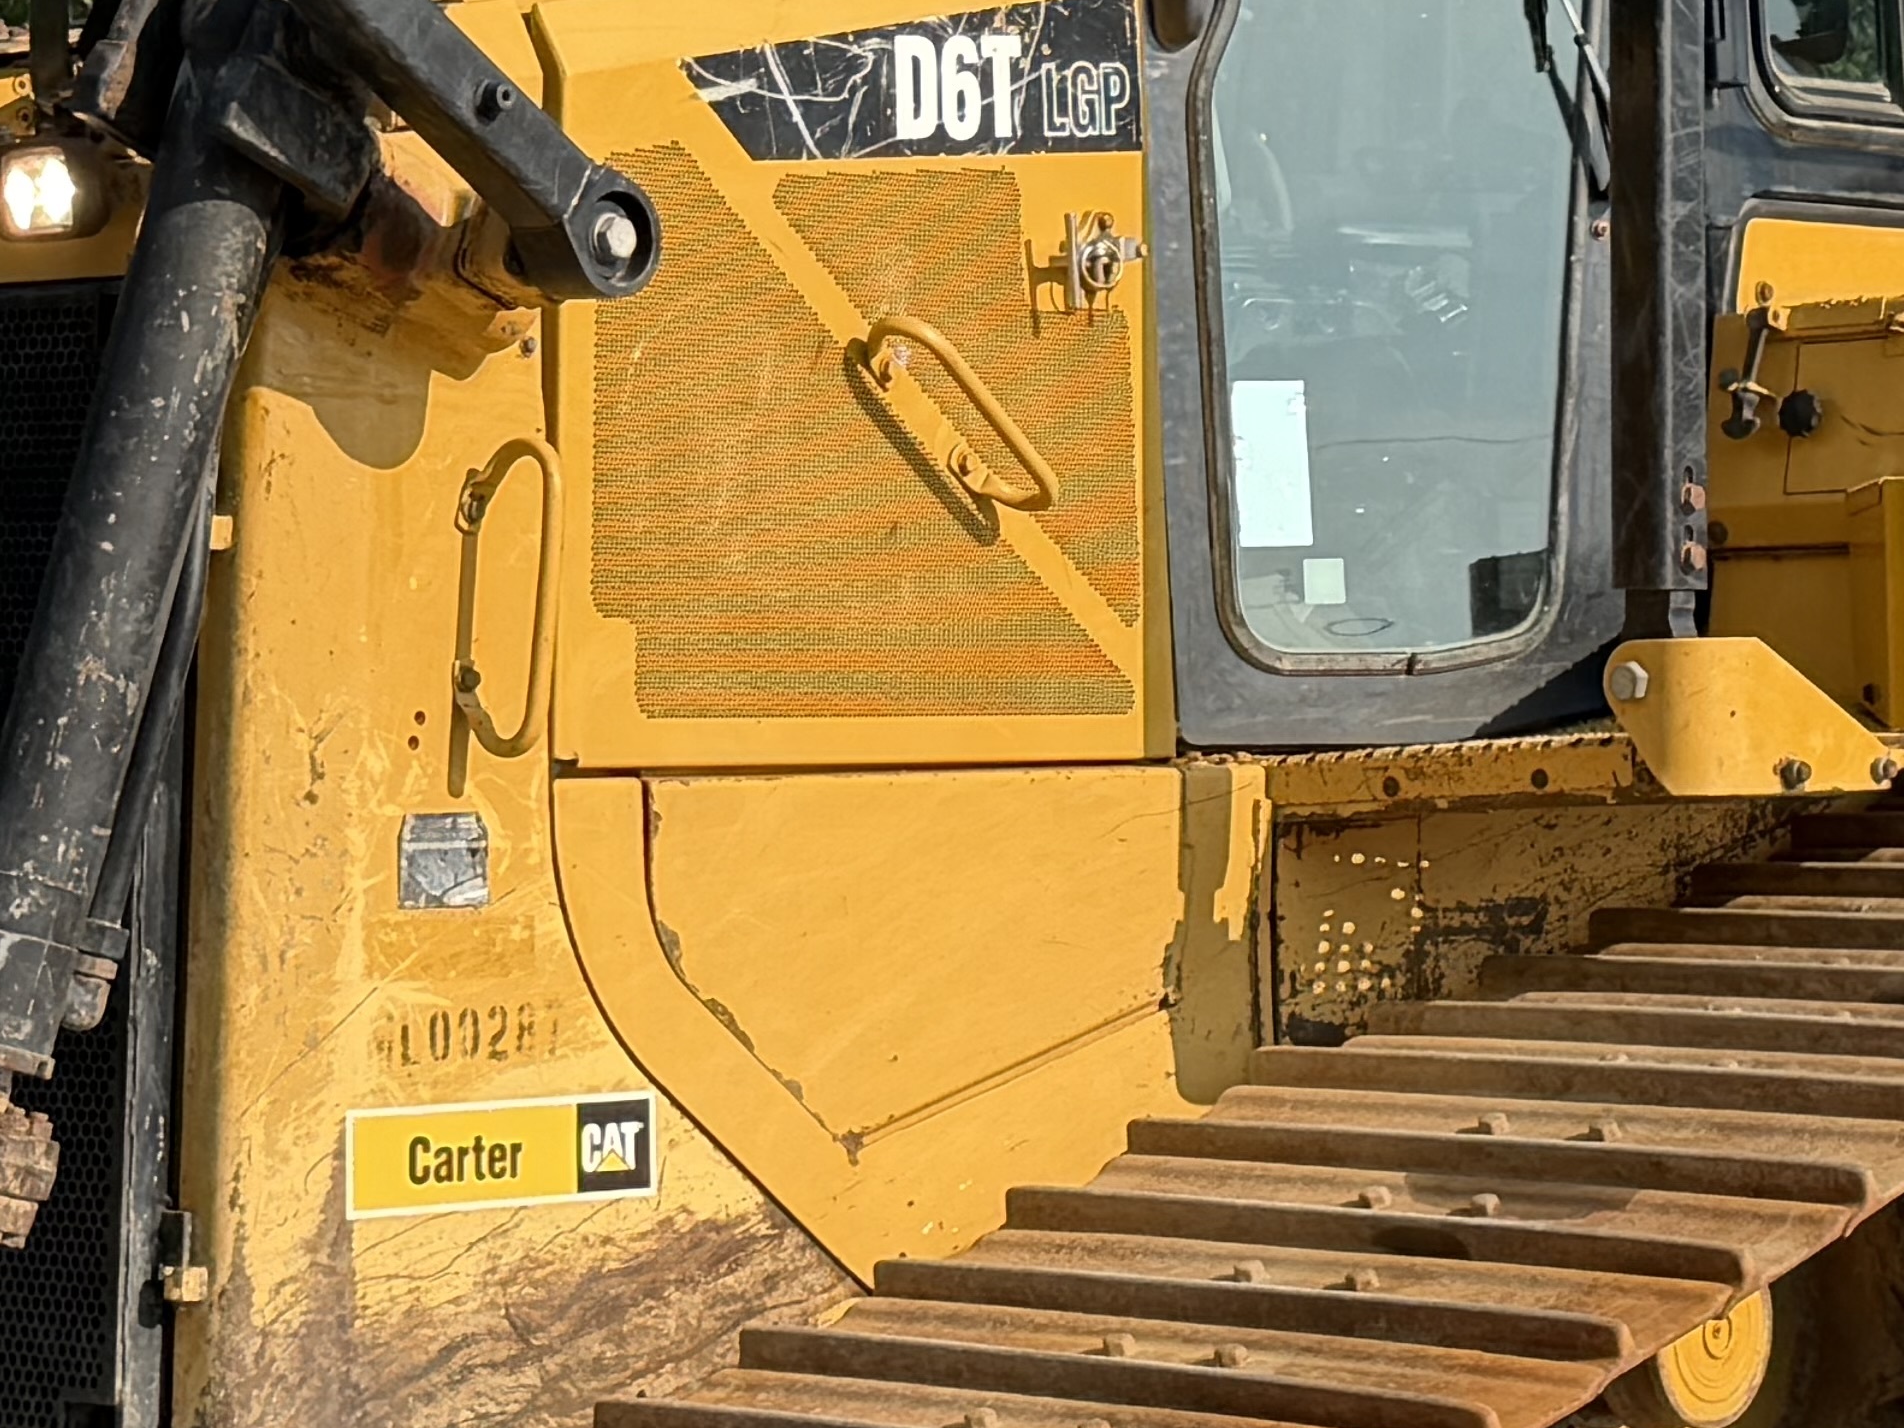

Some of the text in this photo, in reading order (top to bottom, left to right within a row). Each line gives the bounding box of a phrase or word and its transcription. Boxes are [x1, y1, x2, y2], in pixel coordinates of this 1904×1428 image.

[893, 33, 1131, 142] D6T LGP
[407, 1120, 644, 1186] Carter CAT
